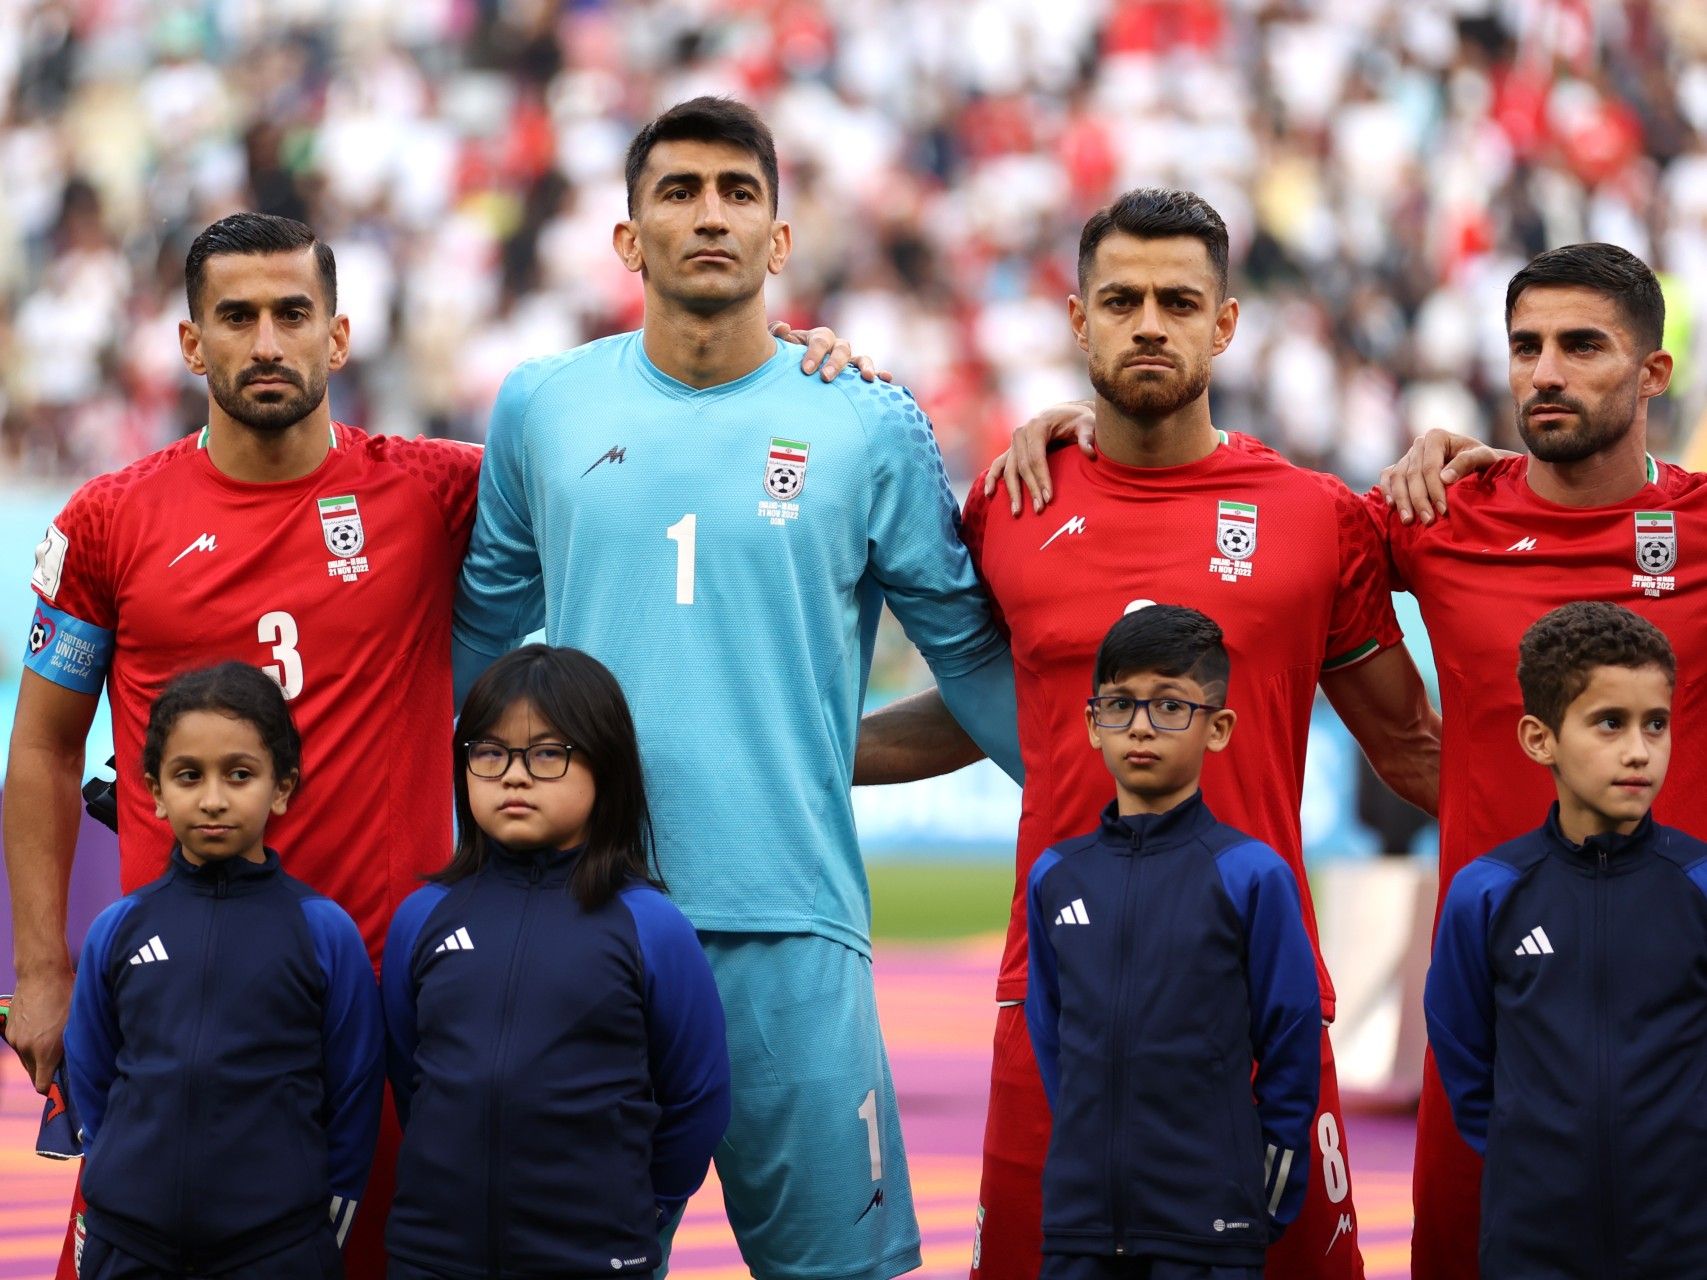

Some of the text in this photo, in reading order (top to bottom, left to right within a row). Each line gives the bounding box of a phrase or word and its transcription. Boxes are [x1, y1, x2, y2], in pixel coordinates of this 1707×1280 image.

[666, 513, 697, 605] 1
[55, 640, 95, 667] UNITES
[60, 630, 96, 654] FOOTBALL
[63, 660, 91, 679] World
[257, 611, 304, 701] 3
[858, 1088, 882, 1182] 1
[1317, 1112, 1349, 1204] 8
